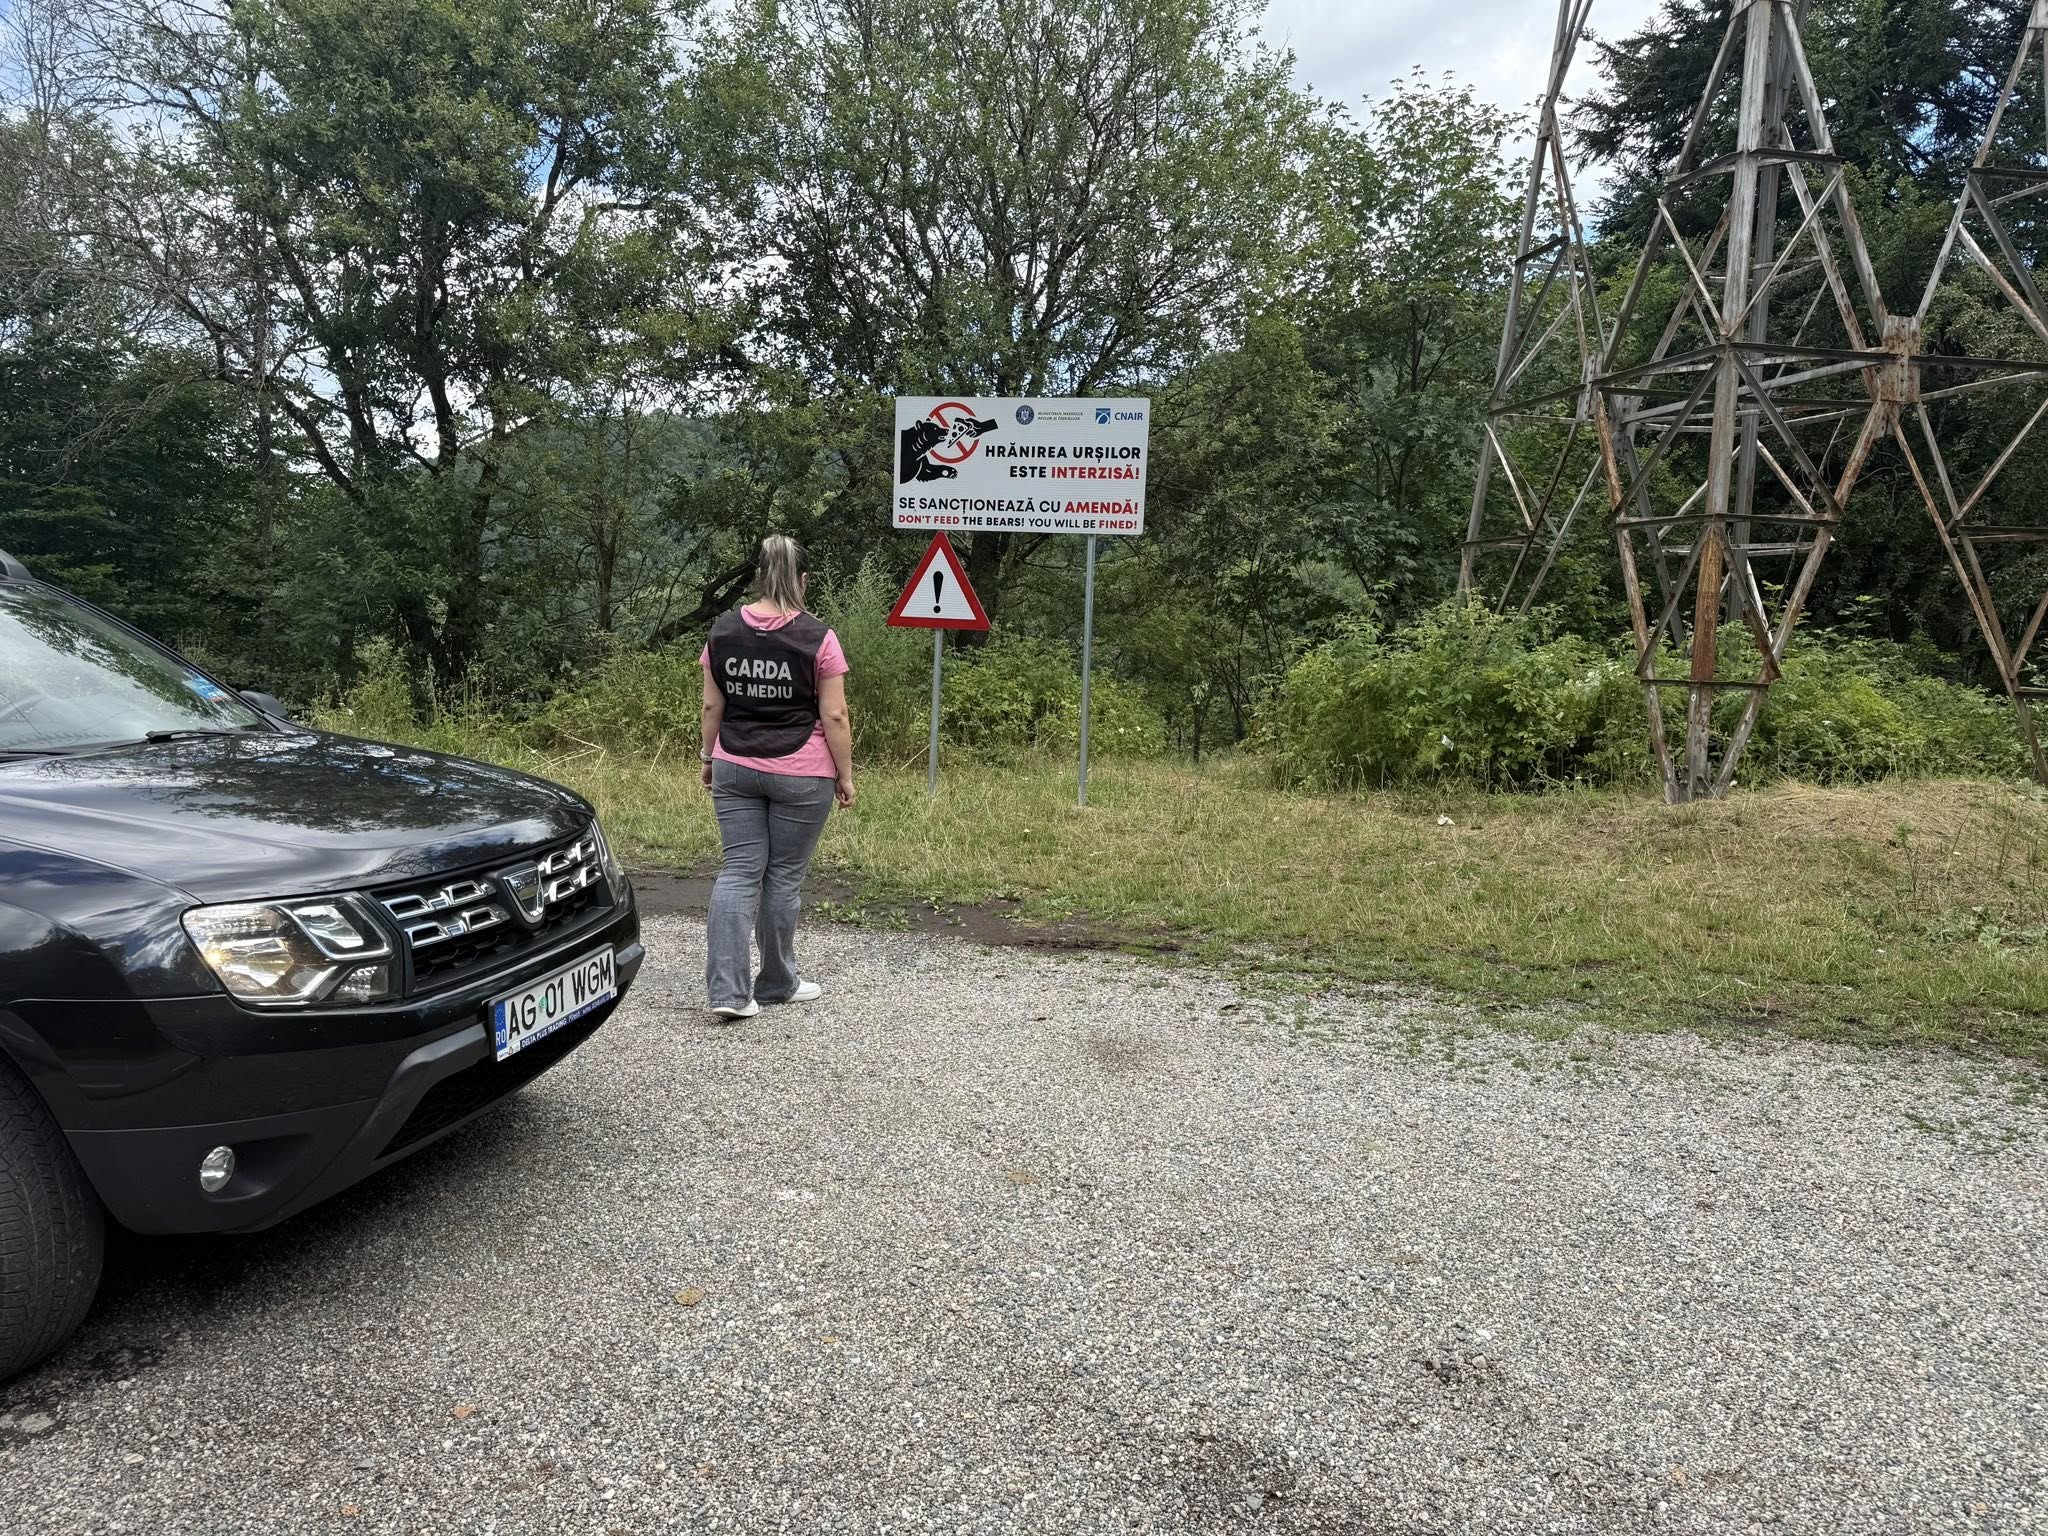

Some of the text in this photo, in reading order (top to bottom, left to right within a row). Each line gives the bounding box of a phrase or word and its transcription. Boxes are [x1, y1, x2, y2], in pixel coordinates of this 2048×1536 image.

[1115, 412, 1143, 420] CNAIR
[986, 442, 1140, 463] HRĂNIREA URȘILOR
[1010, 464, 1140, 480] ESTE INTERZISĂ!
[899, 497, 1138, 514] SE SANCȚIONEAZĂ CU AMENDĂ!
[898, 514, 1137, 529] DON'T FEED THE BEARS! YOU WILL BE FINED!
[725, 657, 792, 680] GARDA
[726, 681, 792, 698] DE MEDIU
[508, 994, 536, 1040] AG
[545, 977, 564, 1018] 01
[572, 953, 612, 1006] WGM
[496, 1028, 506, 1047] RO
[521, 1018, 567, 1048] DELTA PLUS TRADING
